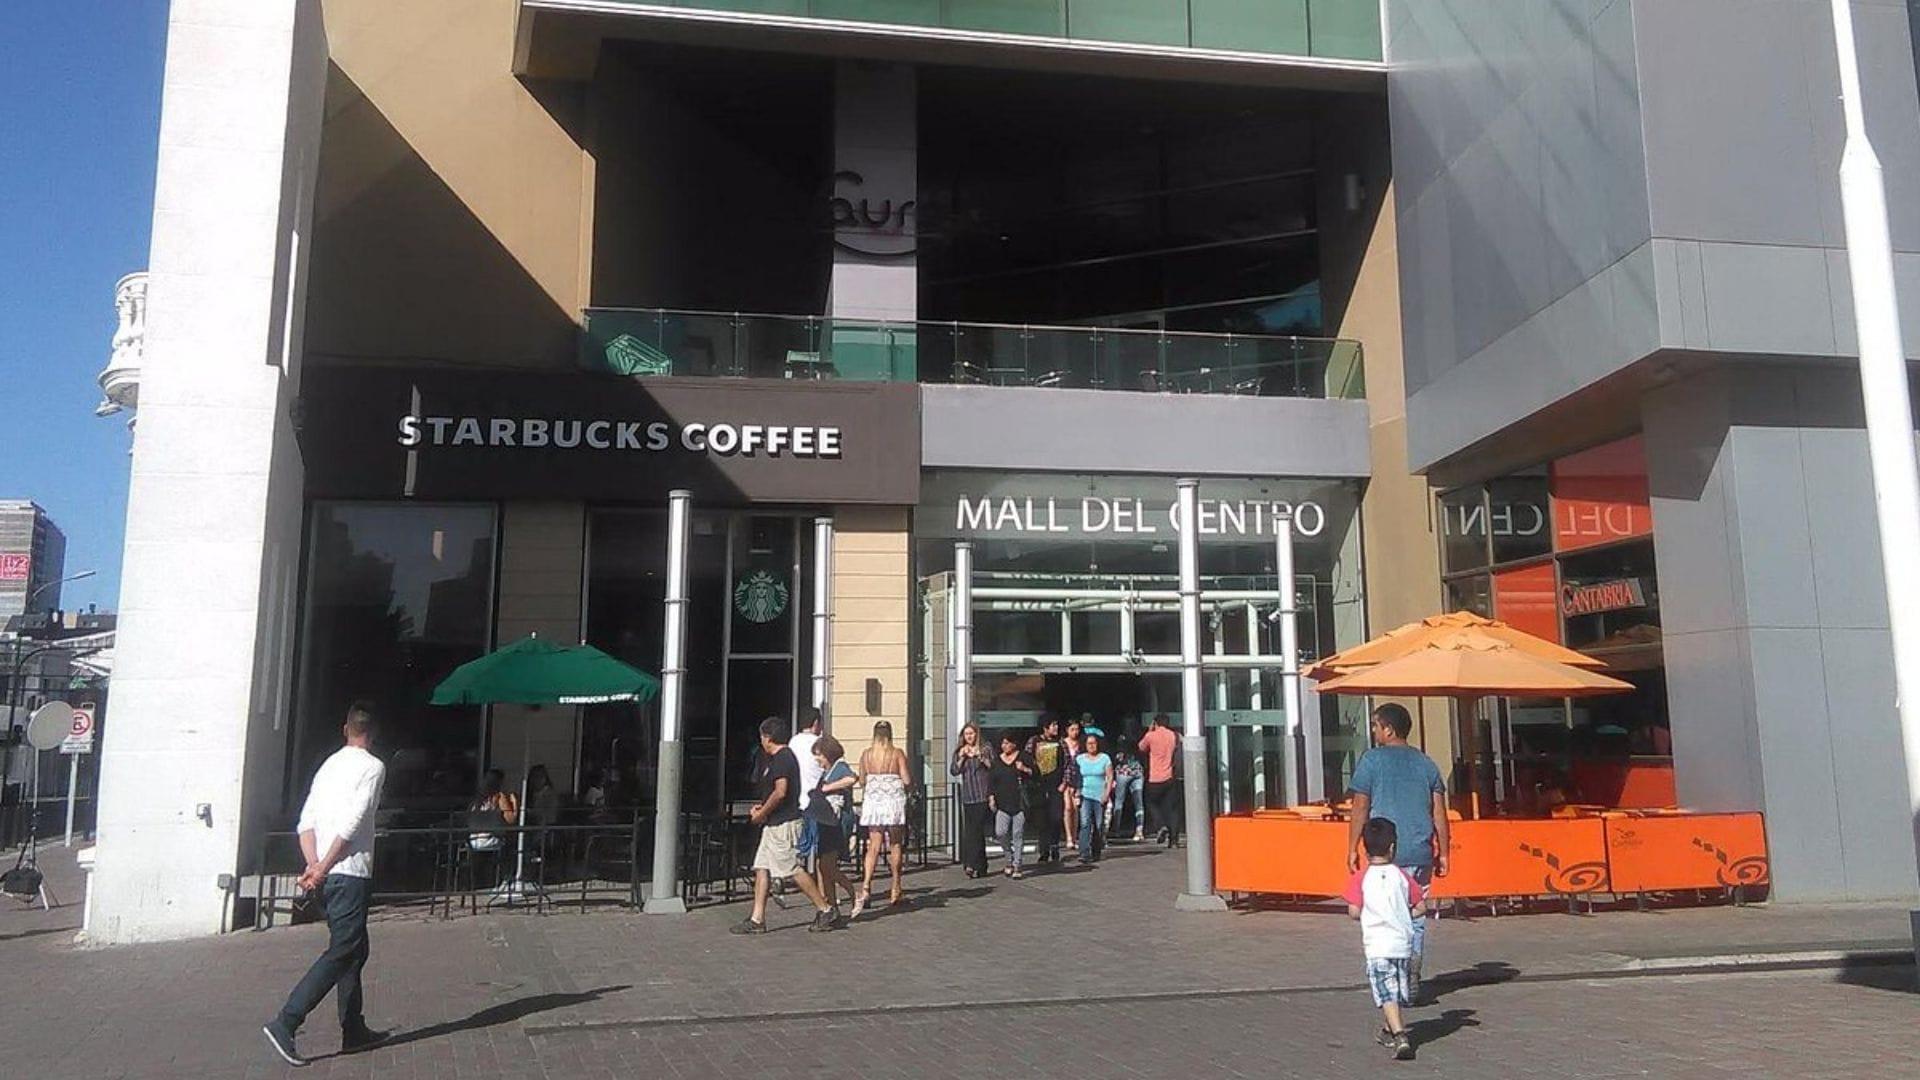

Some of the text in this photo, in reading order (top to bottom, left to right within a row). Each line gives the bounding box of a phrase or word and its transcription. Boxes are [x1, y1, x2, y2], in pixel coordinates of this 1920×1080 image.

[398, 416, 842, 458] STARBUCKS COFFEE
[956, 494, 1069, 533] MALL
[1082, 496, 1156, 534] DEL
[1561, 583, 1635, 615] CANTABRIA
